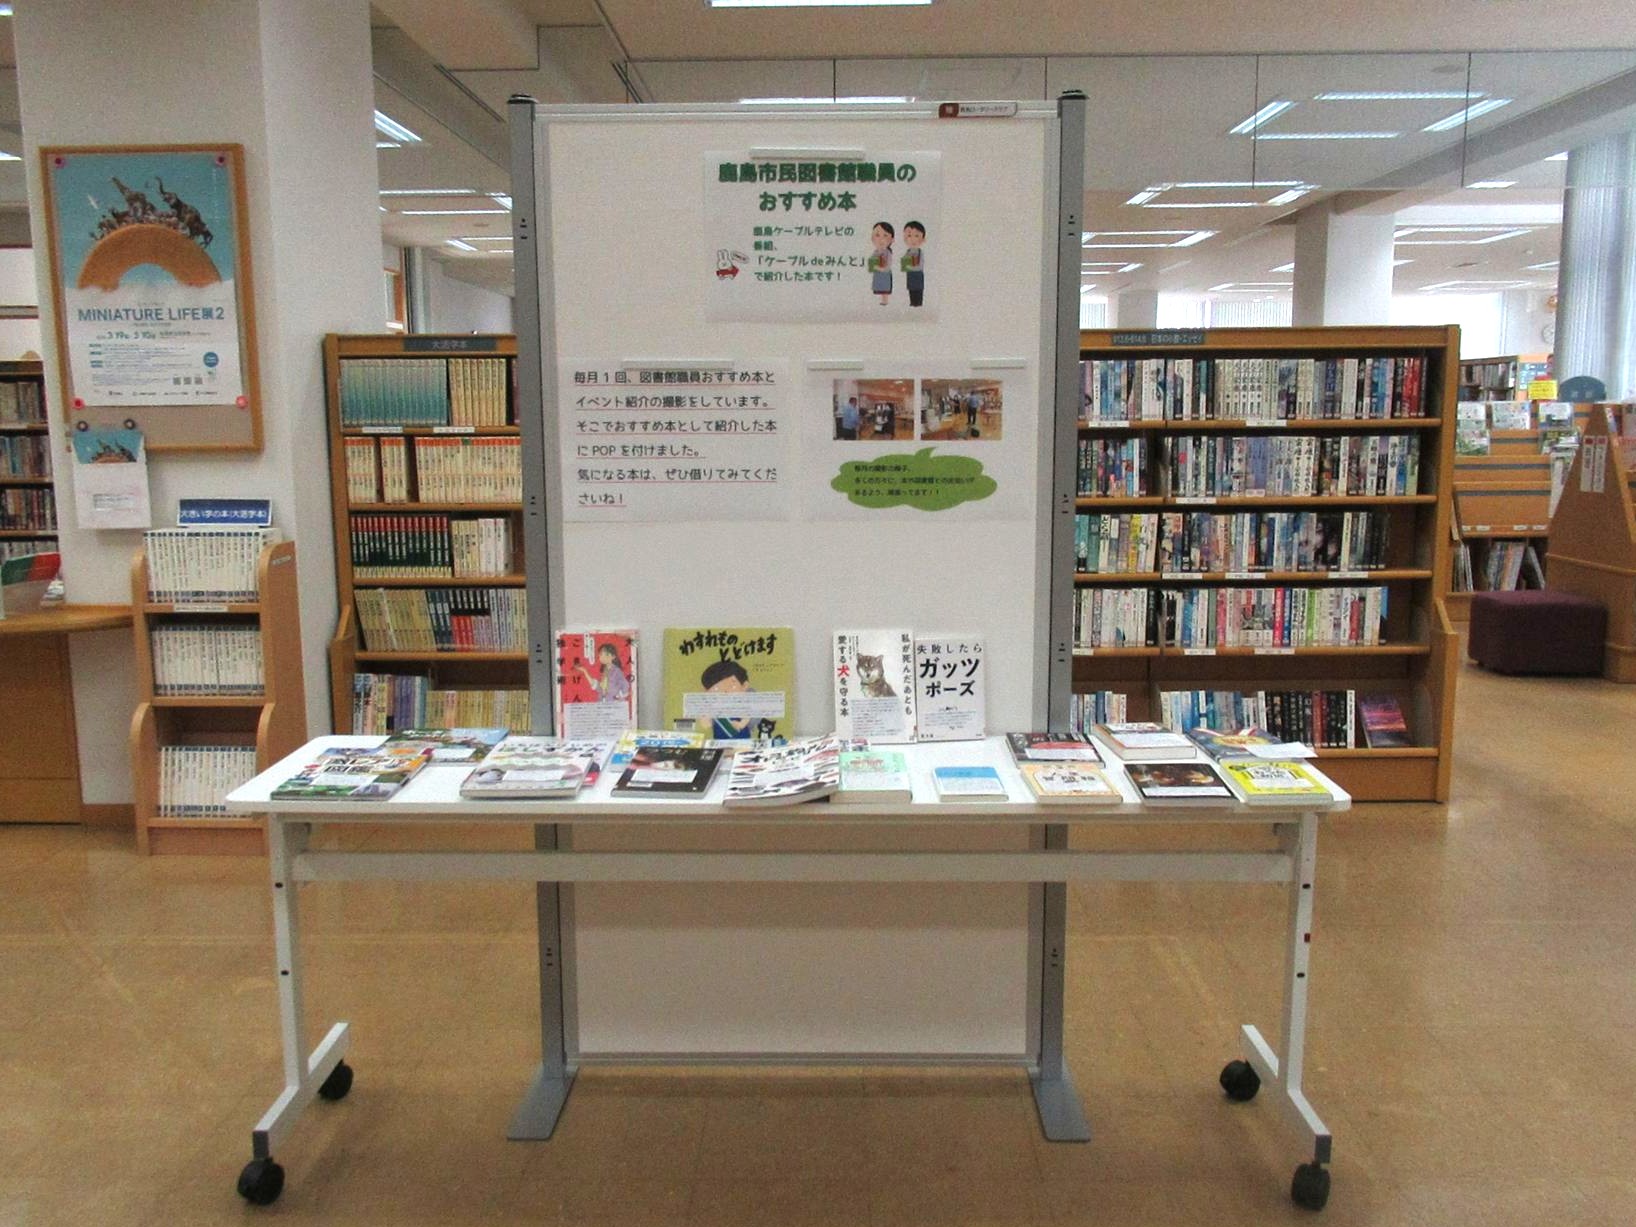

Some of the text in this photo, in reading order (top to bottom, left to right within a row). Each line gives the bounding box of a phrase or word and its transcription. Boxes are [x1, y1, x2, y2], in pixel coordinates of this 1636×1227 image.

[758, 190, 857, 212] おすすめ本
[753, 225, 855, 238] 鹿島ケーブルテレビの
[78, 308, 165, 322] MINIATURE
[576, 420, 777, 433] そこでおすすめ本として紹介した本
[577, 467, 777, 481] 気になる本は、ぜひ借りてみてくだ
[578, 491, 625, 505] さいね！
[679, 630, 738, 657] わすれもの
[719, 633, 777, 663] とどけます
[916, 643, 983, 655] 失敗したら
[837, 635, 850, 717] 愛する犬を守る本
[901, 633, 913, 716] 私が死んだあとも
[919, 657, 981, 679] ガッツ
[925, 680, 977, 698] ポーズ
